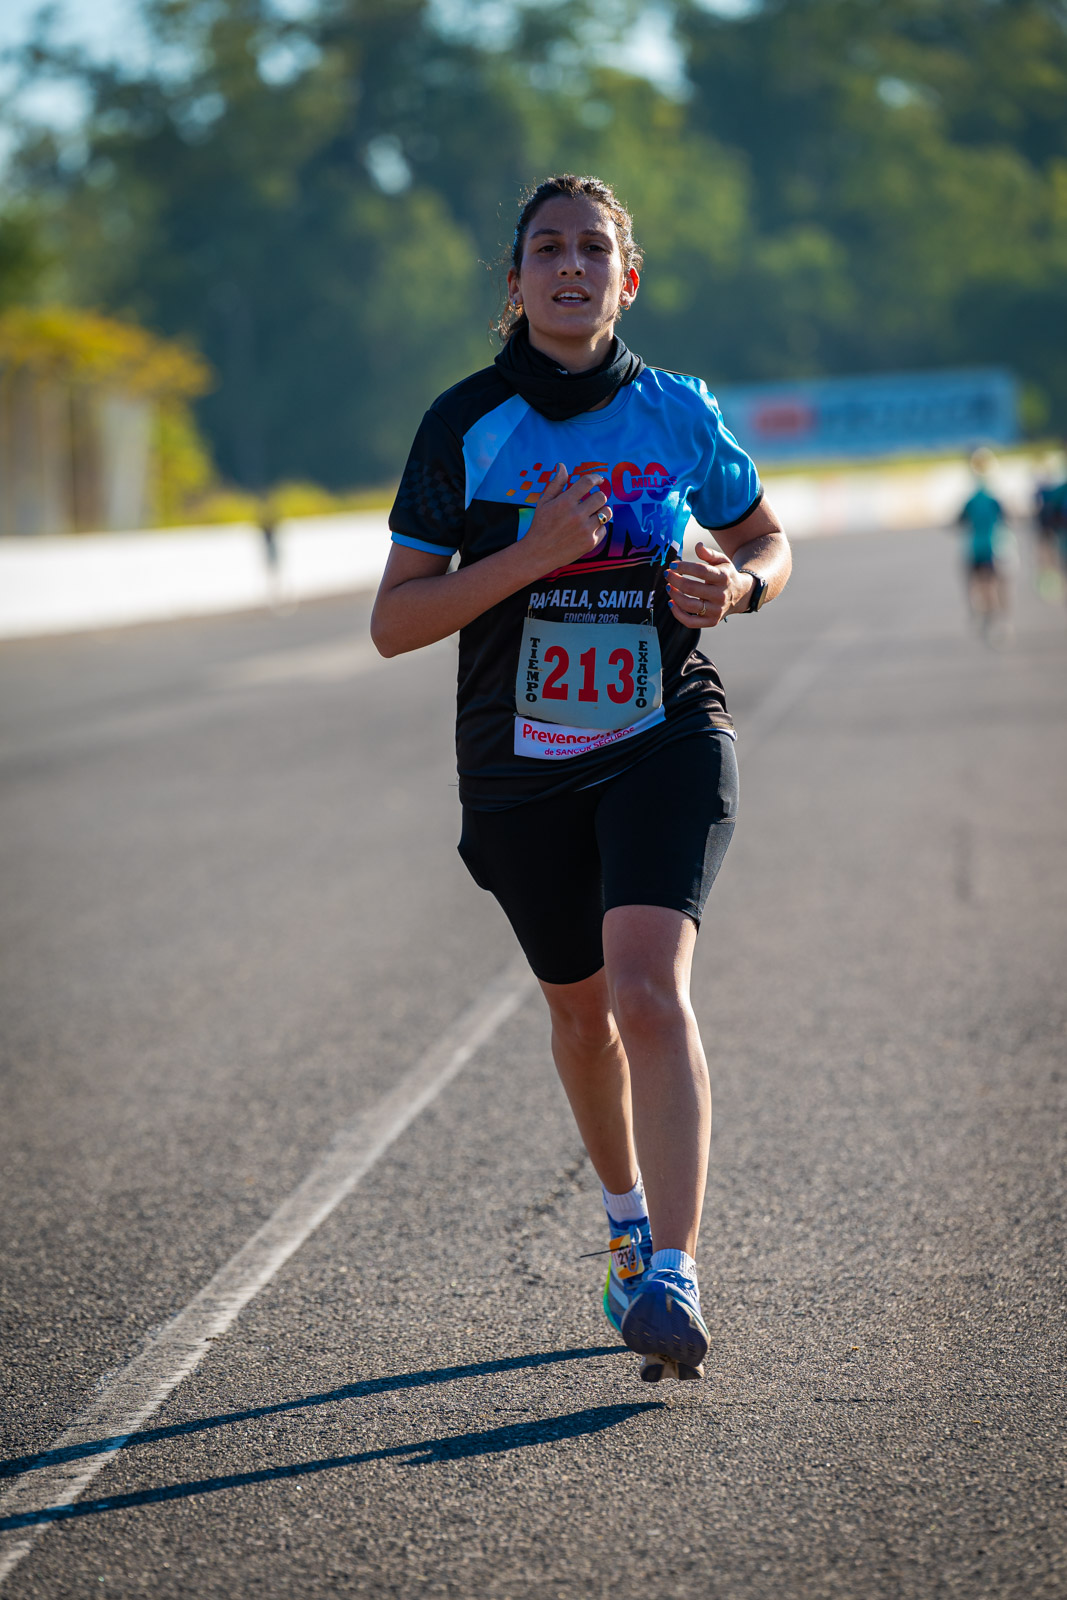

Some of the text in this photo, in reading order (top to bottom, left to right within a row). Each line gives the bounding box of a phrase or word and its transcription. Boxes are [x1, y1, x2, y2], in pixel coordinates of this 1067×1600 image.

[631, 476, 678, 489] MILLAS
[530, 589, 593, 610] RAFAELA,
[597, 590, 643, 608] SANTA
[563, 611, 620, 624] EDICIÓN 2026
[525, 637, 541, 703] TIEMPO
[542, 645, 635, 704] 213
[635, 640, 649, 709] EXACTO
[522, 723, 611, 745] Prevenci
[544, 748, 554, 756] de
[556, 745, 592, 756] SANCOR
